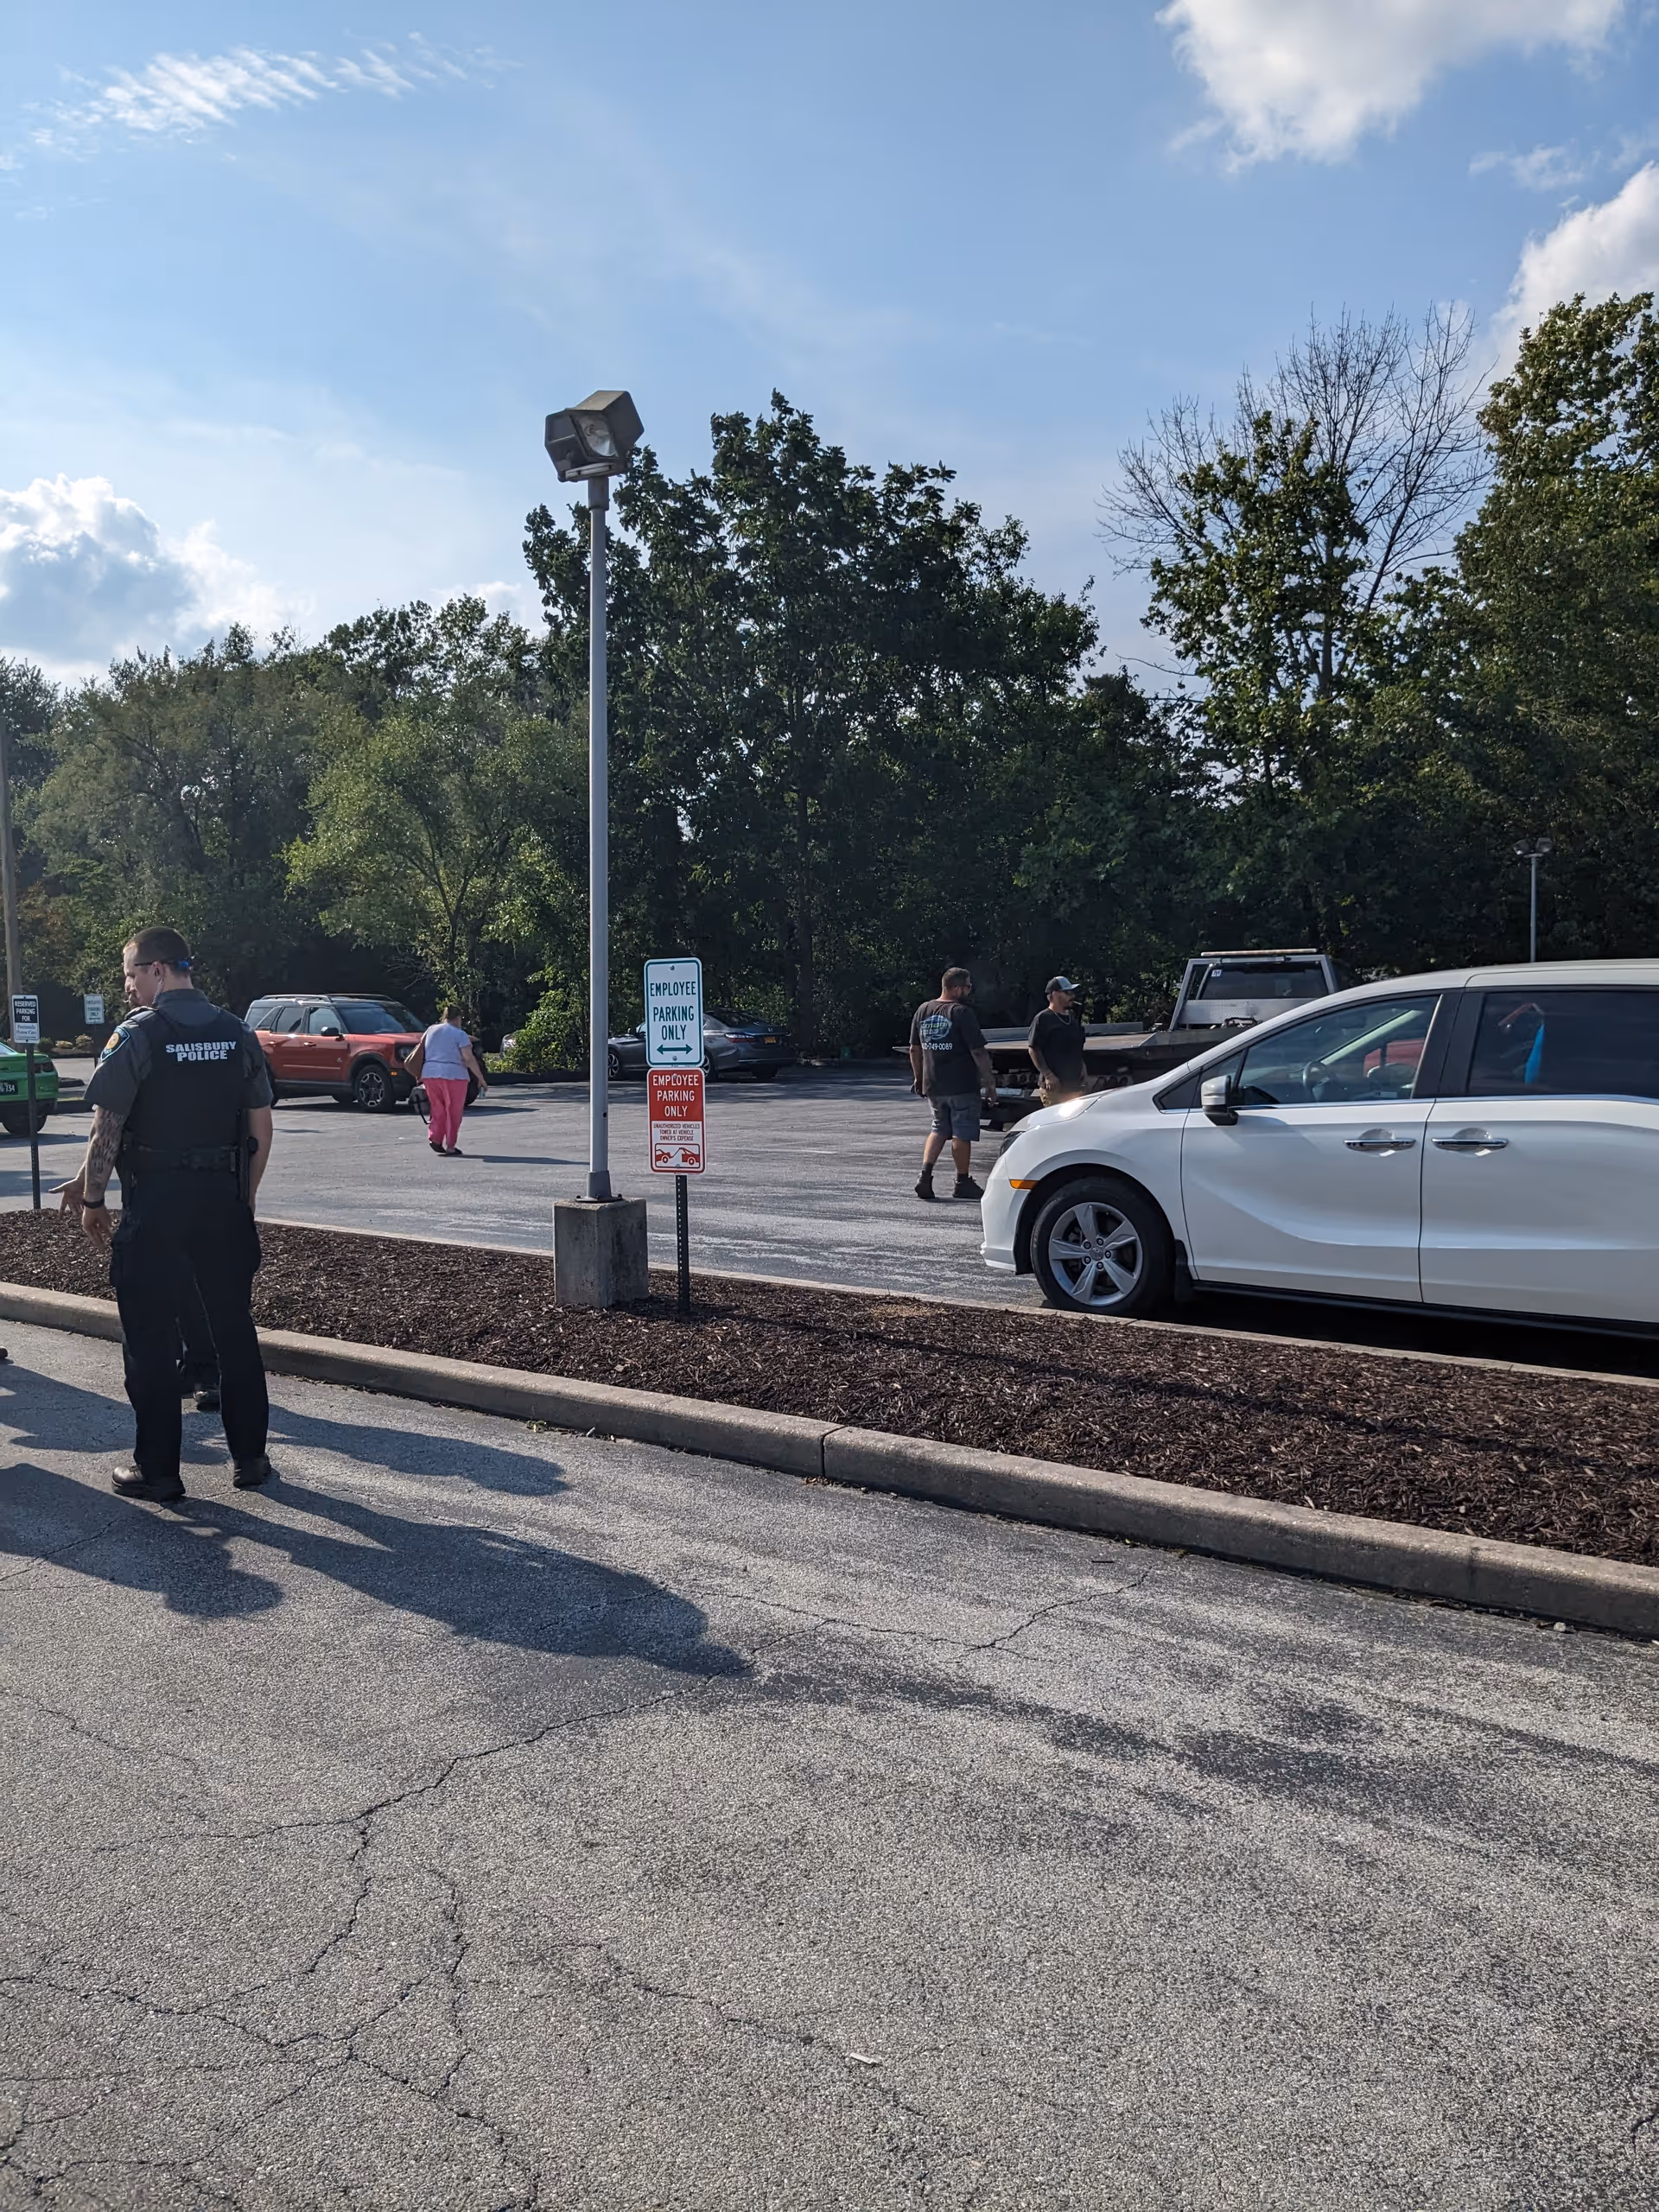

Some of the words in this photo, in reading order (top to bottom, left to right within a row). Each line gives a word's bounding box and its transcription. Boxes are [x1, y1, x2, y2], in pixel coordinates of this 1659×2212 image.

[650, 982, 696, 996] EMPLOYEE
[653, 1006, 695, 1022] PARKING
[661, 1024, 687, 1040] ONLY
[165, 1041, 237, 1053] SALISBURY
[176, 1050, 228, 1062] POLICE
[652, 1074, 699, 1086] EMPLOYEE
[657, 1090, 695, 1102] PARKING
[664, 1105, 688, 1117] ONLY
